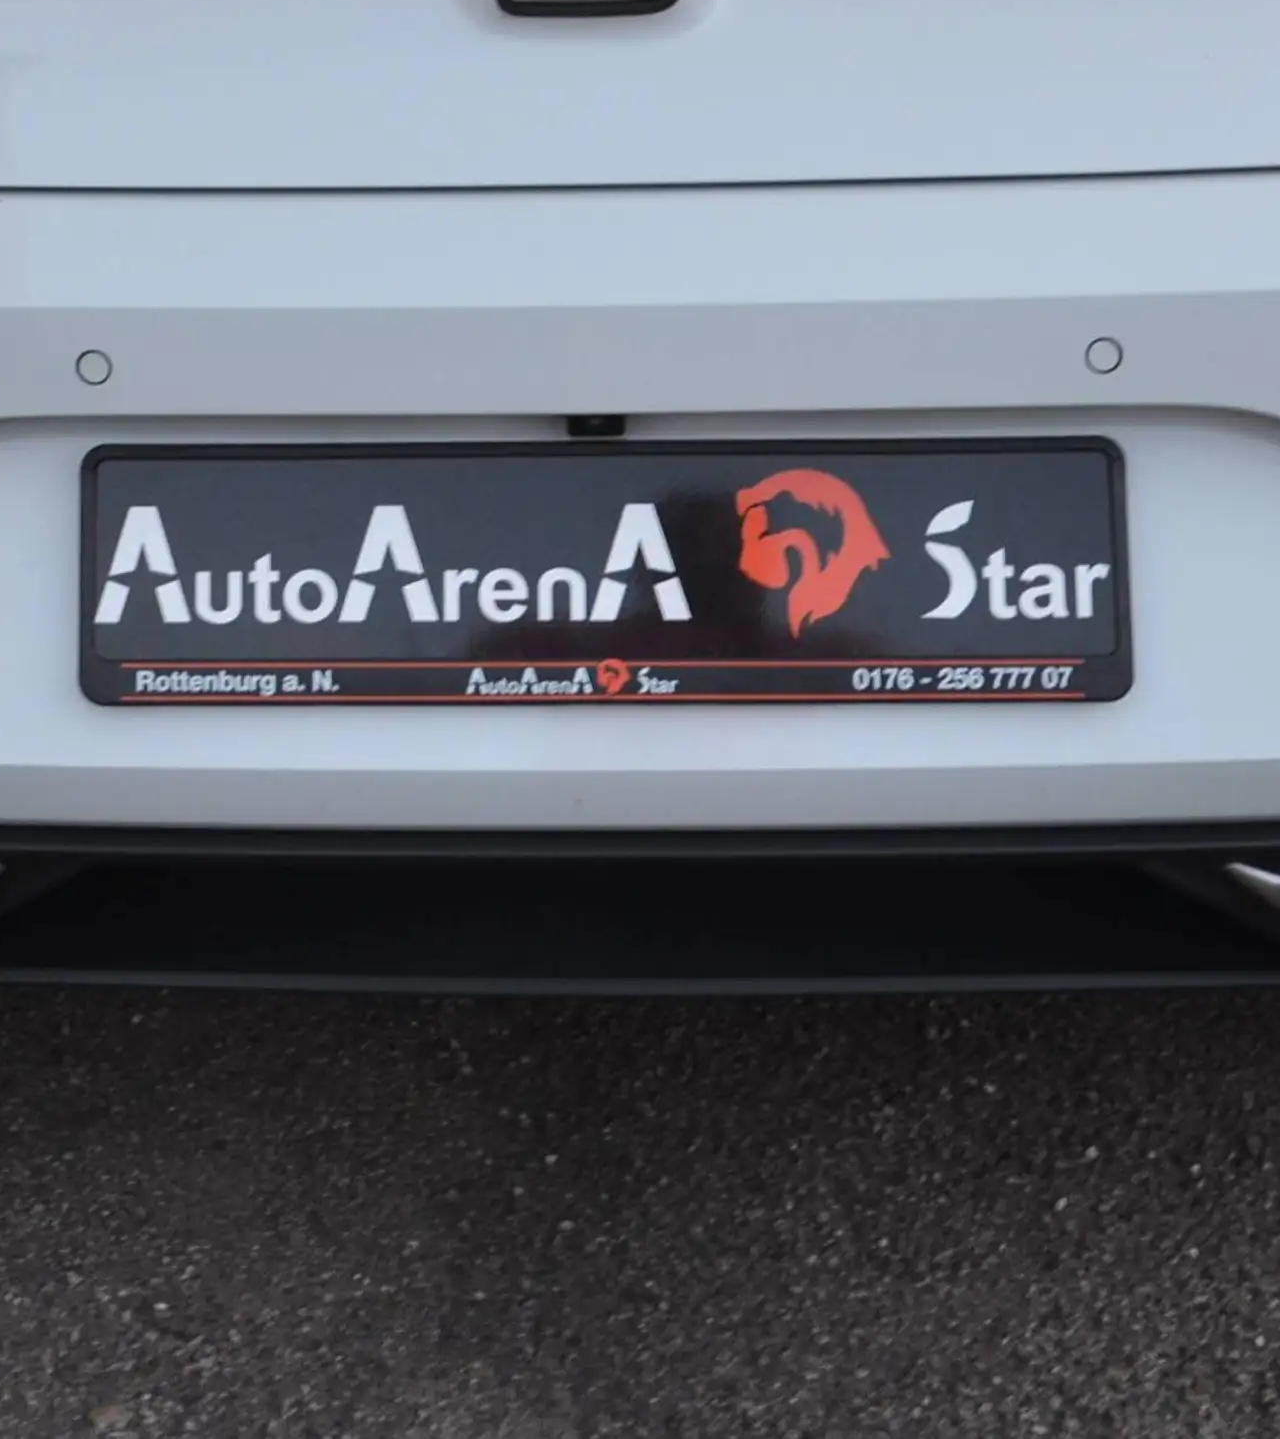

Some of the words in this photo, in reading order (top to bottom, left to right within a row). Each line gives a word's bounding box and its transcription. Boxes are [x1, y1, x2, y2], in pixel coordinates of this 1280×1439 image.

[93, 503, 693, 624] AutoArenA
[920, 499, 1111, 620] Star
[135, 669, 277, 696] Rottenburg
[282, 674, 306, 692] a.
[311, 669, 340, 692] N.
[465, 666, 595, 695] AutoArenA
[636, 666, 679, 694] Star
[852, 667, 915, 691] 0176
[936, 667, 985, 690] 256
[989, 666, 1036, 690] 777
[1040, 666, 1074, 689] 07
